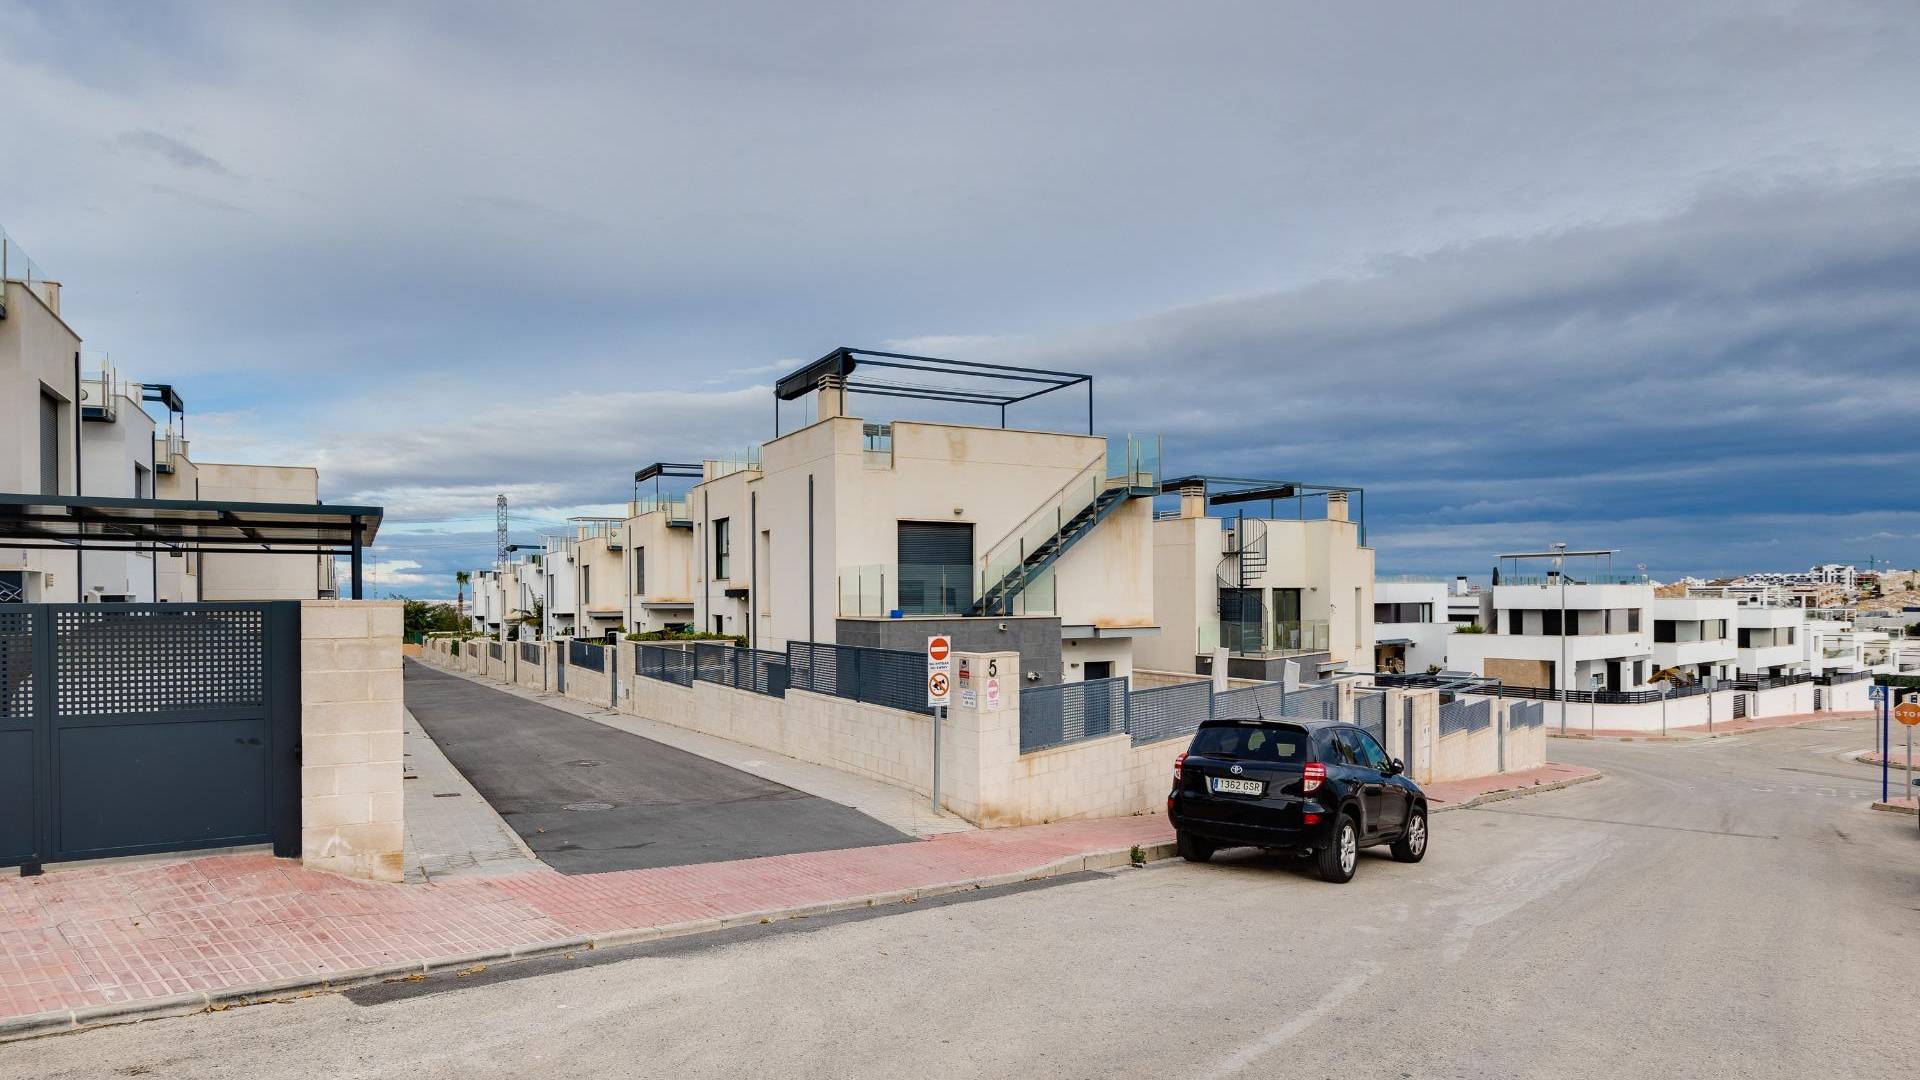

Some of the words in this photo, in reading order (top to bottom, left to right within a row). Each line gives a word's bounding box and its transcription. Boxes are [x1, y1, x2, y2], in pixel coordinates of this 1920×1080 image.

[989, 659, 997, 677] 5
[1221, 780, 1241, 790] 1362
[1243, 781, 1260, 792] GSR
